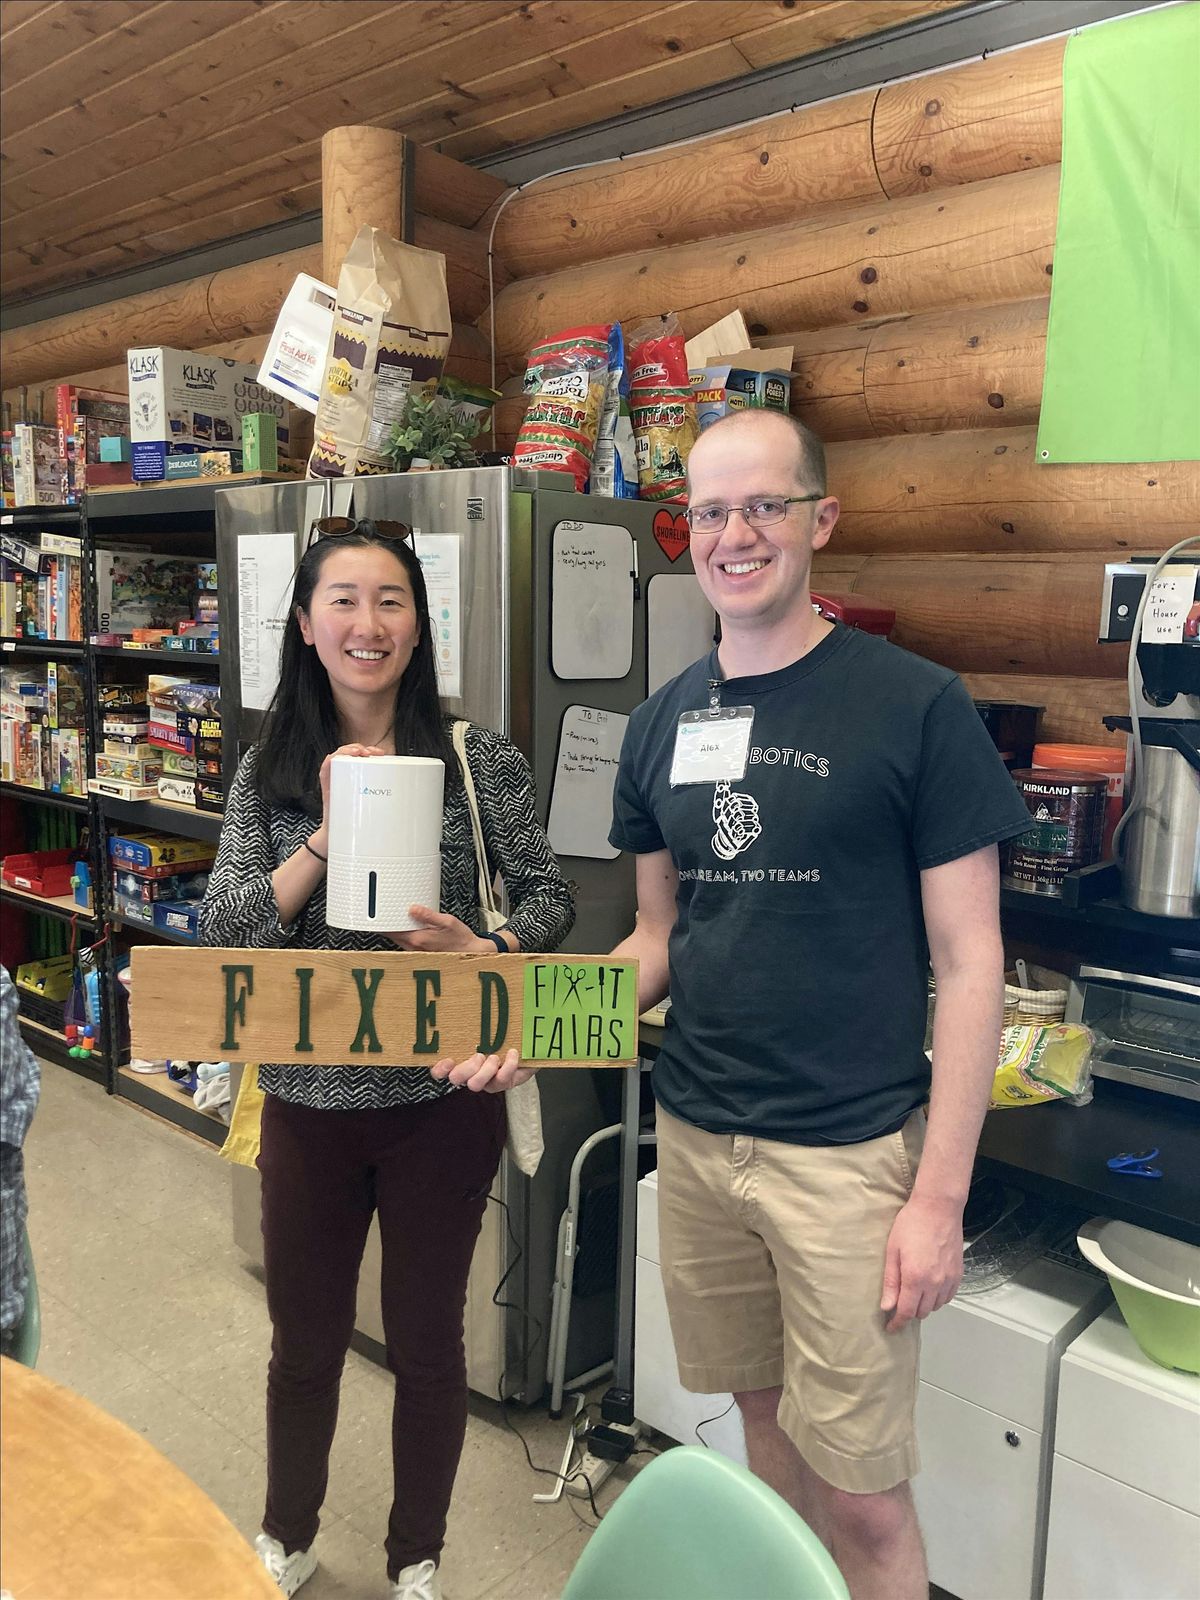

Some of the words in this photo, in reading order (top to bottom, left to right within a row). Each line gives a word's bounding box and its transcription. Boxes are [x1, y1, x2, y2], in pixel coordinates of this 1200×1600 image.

[130, 355, 159, 374] KLASK
[183, 365, 217, 385] KLASK
[766, 388, 785, 398] FOREST
[767, 381, 783, 391] BLACK
[697, 390, 722, 402] PACK
[656, 526, 690, 542] SHORELINE
[1150, 595, 1165, 604] In
[1153, 607, 1178, 618] House
[749, 746, 830, 777] BOTICS
[1023, 783, 1070, 796] KIRKLAND
[740, 869, 765, 881] TWO
[768, 869, 821, 882] TEAMS
[535, 965, 625, 1009] FIX-IT
[220, 965, 509, 1054] FIXED
[532, 1014, 623, 1059] FAIRS
